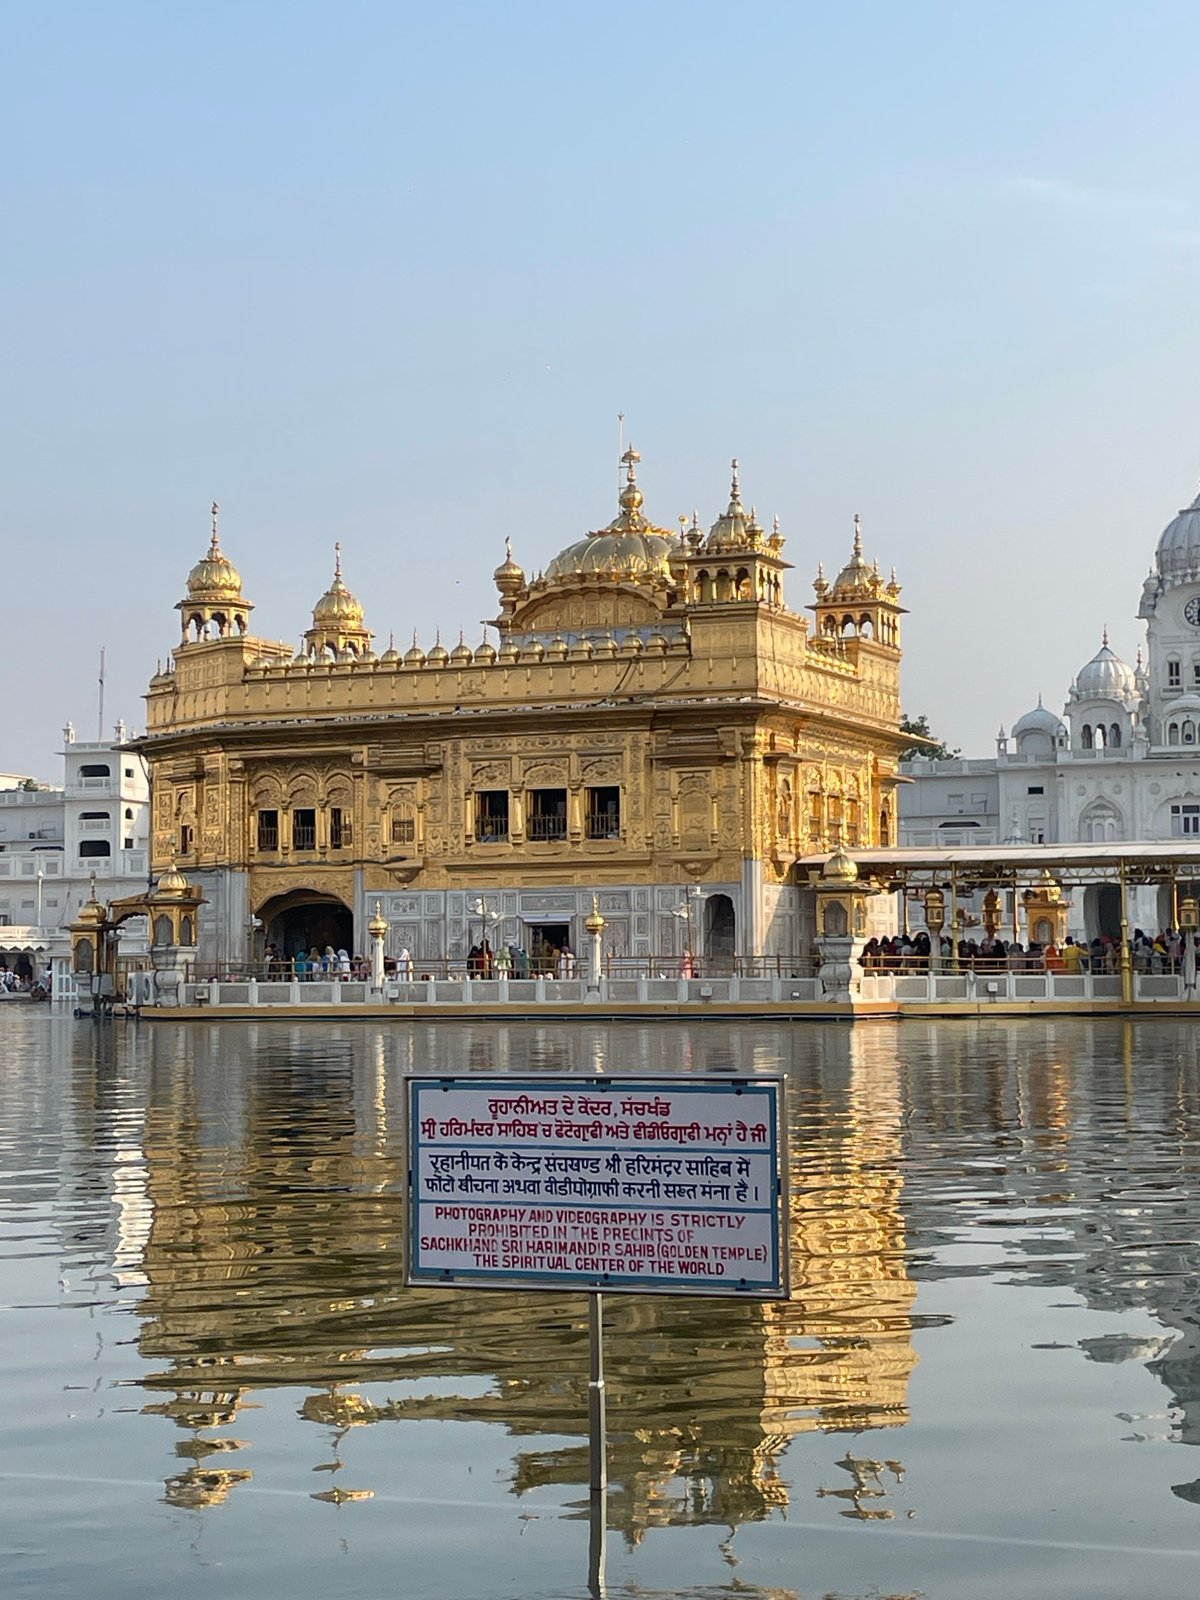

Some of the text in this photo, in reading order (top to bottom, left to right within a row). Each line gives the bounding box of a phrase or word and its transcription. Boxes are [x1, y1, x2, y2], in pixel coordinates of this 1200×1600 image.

[562, 1096, 574, 1116] ਦੇ
[421, 1118, 436, 1140] ਸ੍ਰੀ
[439, 1118, 495, 1137] ਹਰਿਮੰਦਰ
[497, 1118, 538, 1138] ਸਾਹਿਬ
[605, 1120, 630, 1140] ਅਤੇ
[736, 1121, 748, 1142] ਹੈ
[750, 1123, 767, 1143] ਜੀ
[605, 1153, 622, 1174] श्री
[686, 1156, 732, 1177] साहिब
[623, 1178, 661, 1198] करनी
[435, 1207, 746, 1230] PHOTOGRAPHY AND VIDEOGRAPHY IS STRICTLY
[469, 1223, 694, 1244] PROHIBITED IN THE PRECINTS OF
[420, 1237, 498, 1252] SACHKHAND
[502, 1238, 523, 1253] SRI
[526, 1239, 612, 1256] HARIMANDIR
[615, 1242, 656, 1258] SAHIB
[473, 1253, 725, 1276] THE SPIRITUAL CENTER OF THE WORLD
